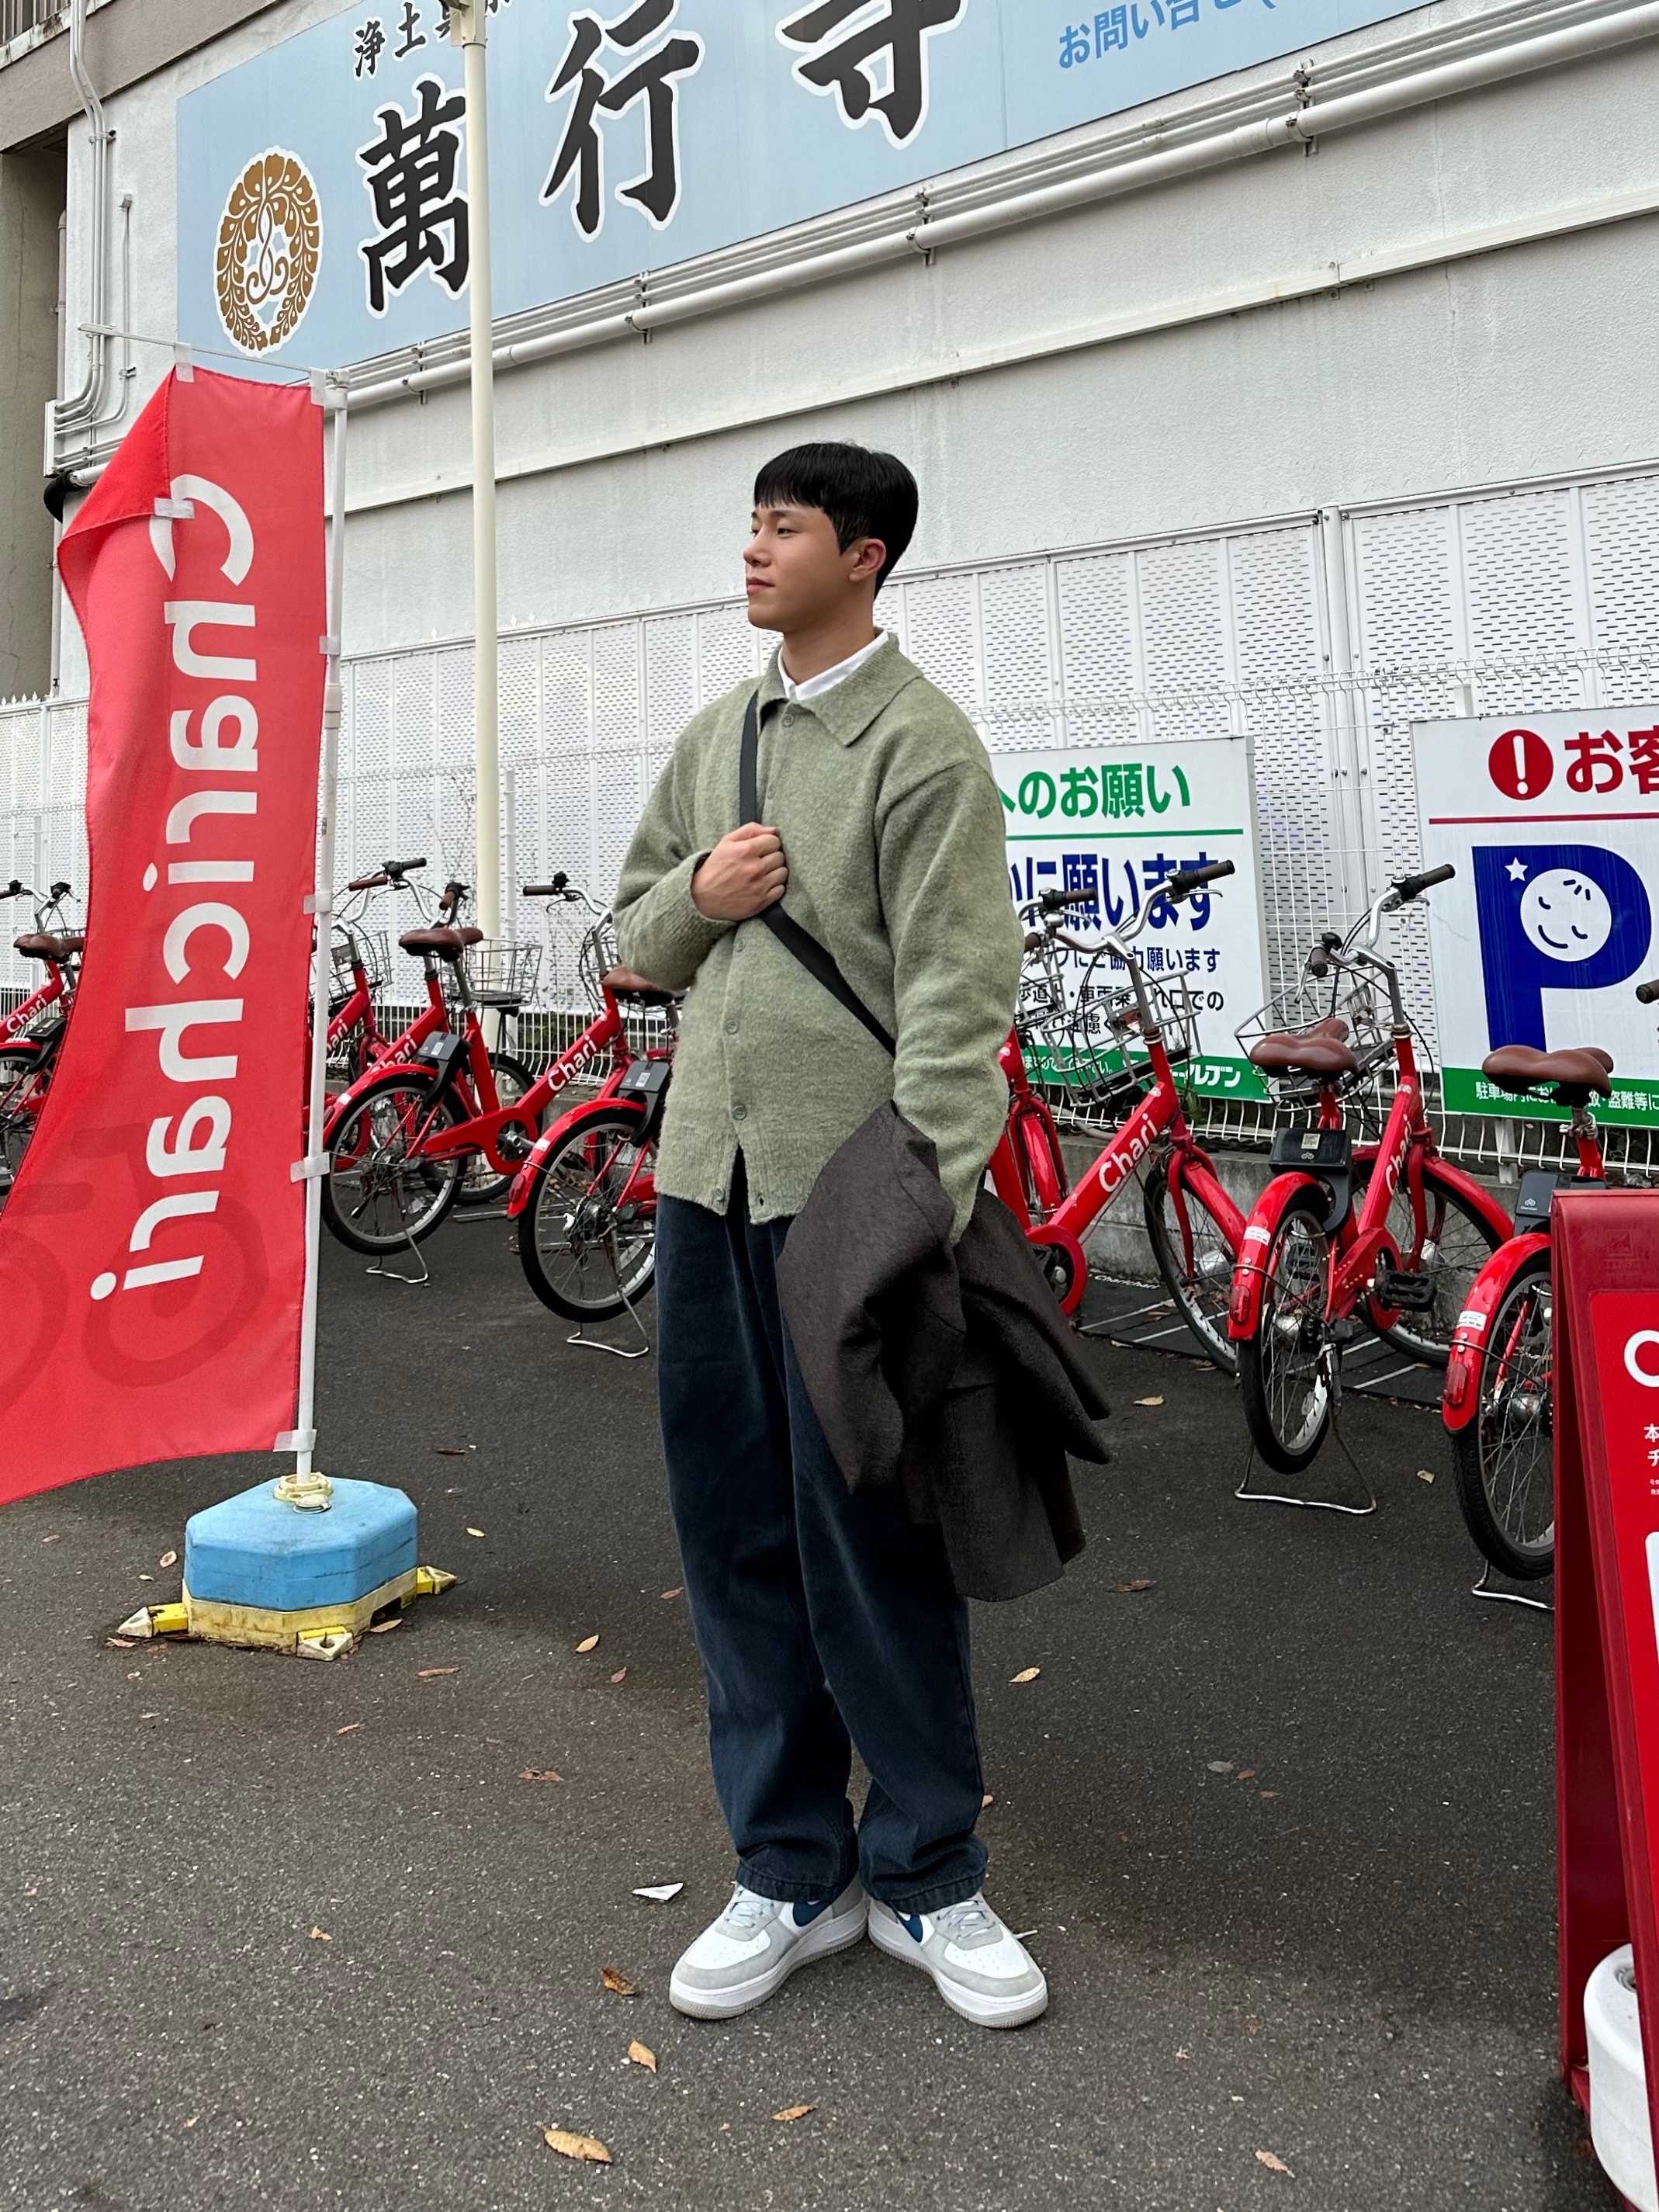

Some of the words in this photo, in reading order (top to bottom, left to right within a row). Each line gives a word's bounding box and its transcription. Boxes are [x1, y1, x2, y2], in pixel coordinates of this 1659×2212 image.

[1471, 844, 1652, 1052] P
[6, 993, 47, 1033] Chari
[326, 1018, 348, 1052] ari
[547, 1035, 597, 1091] Chari
[1098, 1113, 1159, 1193] Chari
